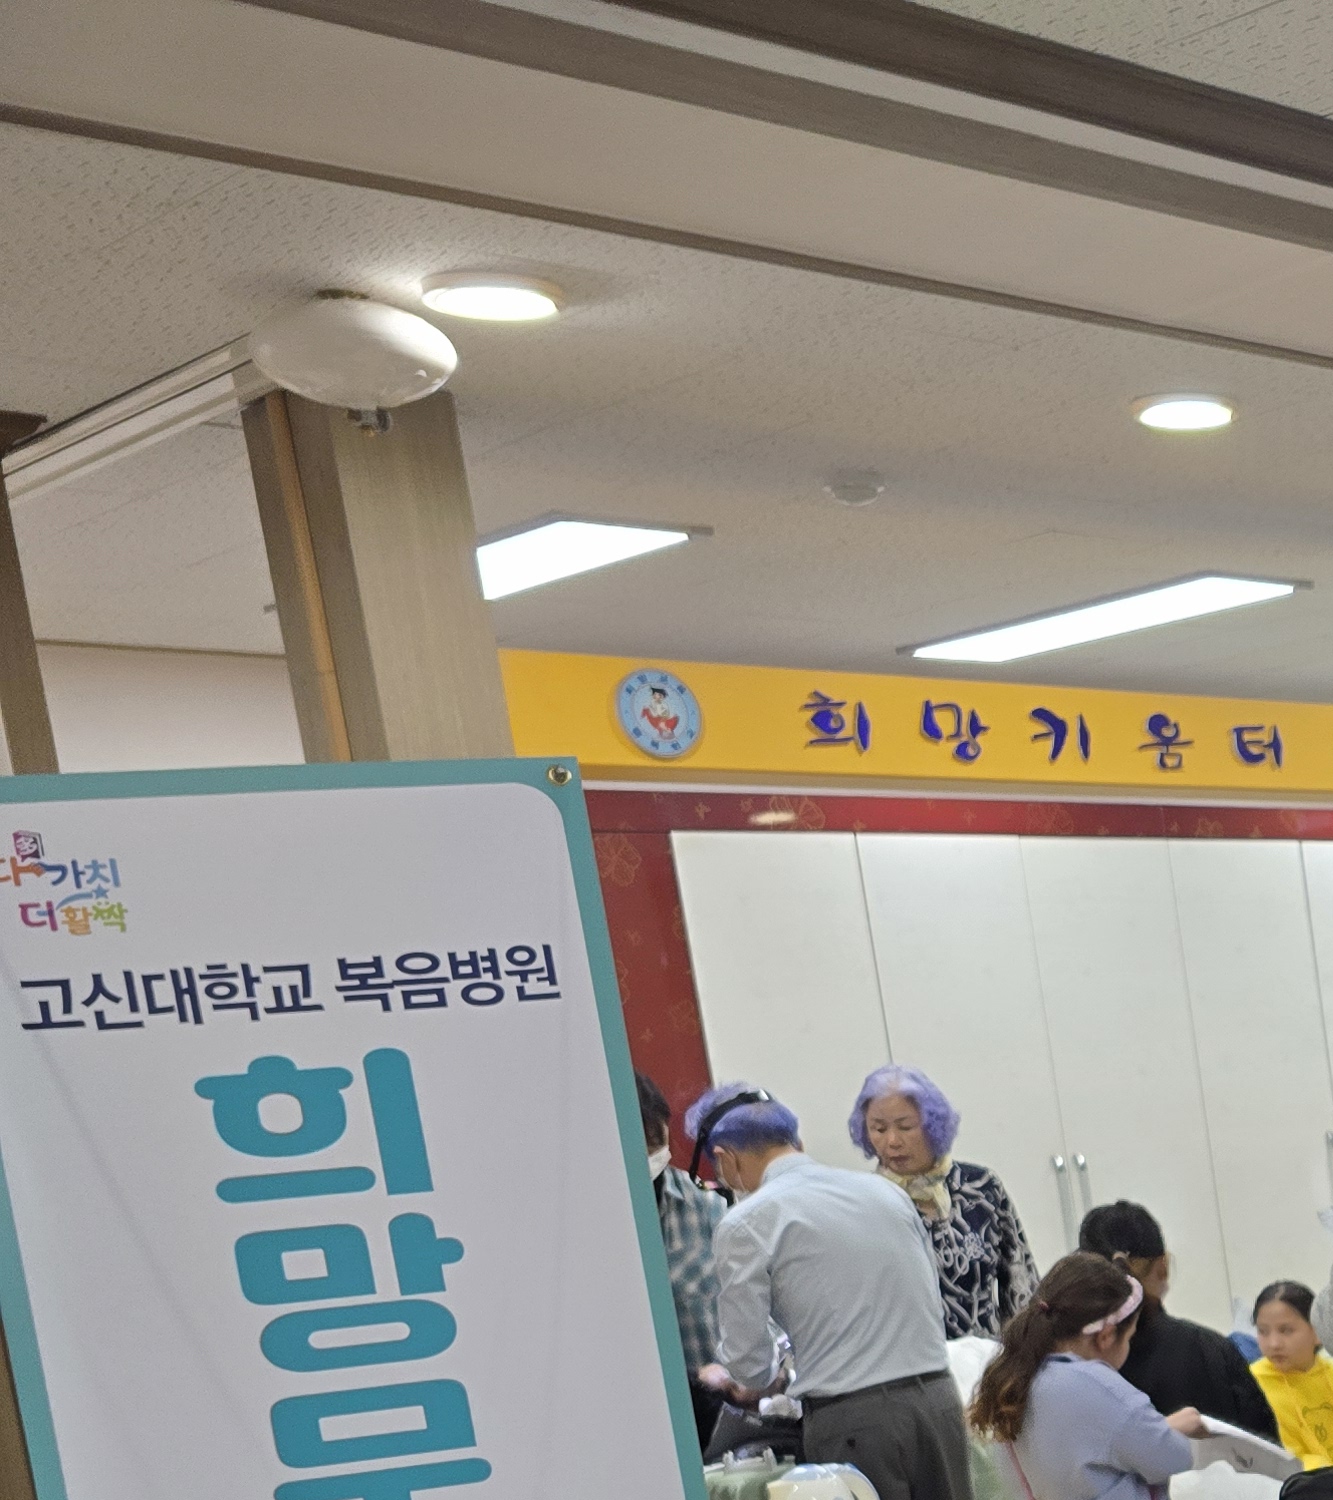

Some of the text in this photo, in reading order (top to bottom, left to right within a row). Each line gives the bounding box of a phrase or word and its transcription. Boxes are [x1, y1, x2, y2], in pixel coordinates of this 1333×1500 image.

[800, 690, 1283, 770] 희망키움터
[20, 943, 562, 1032] 고신대학교 복음병원
